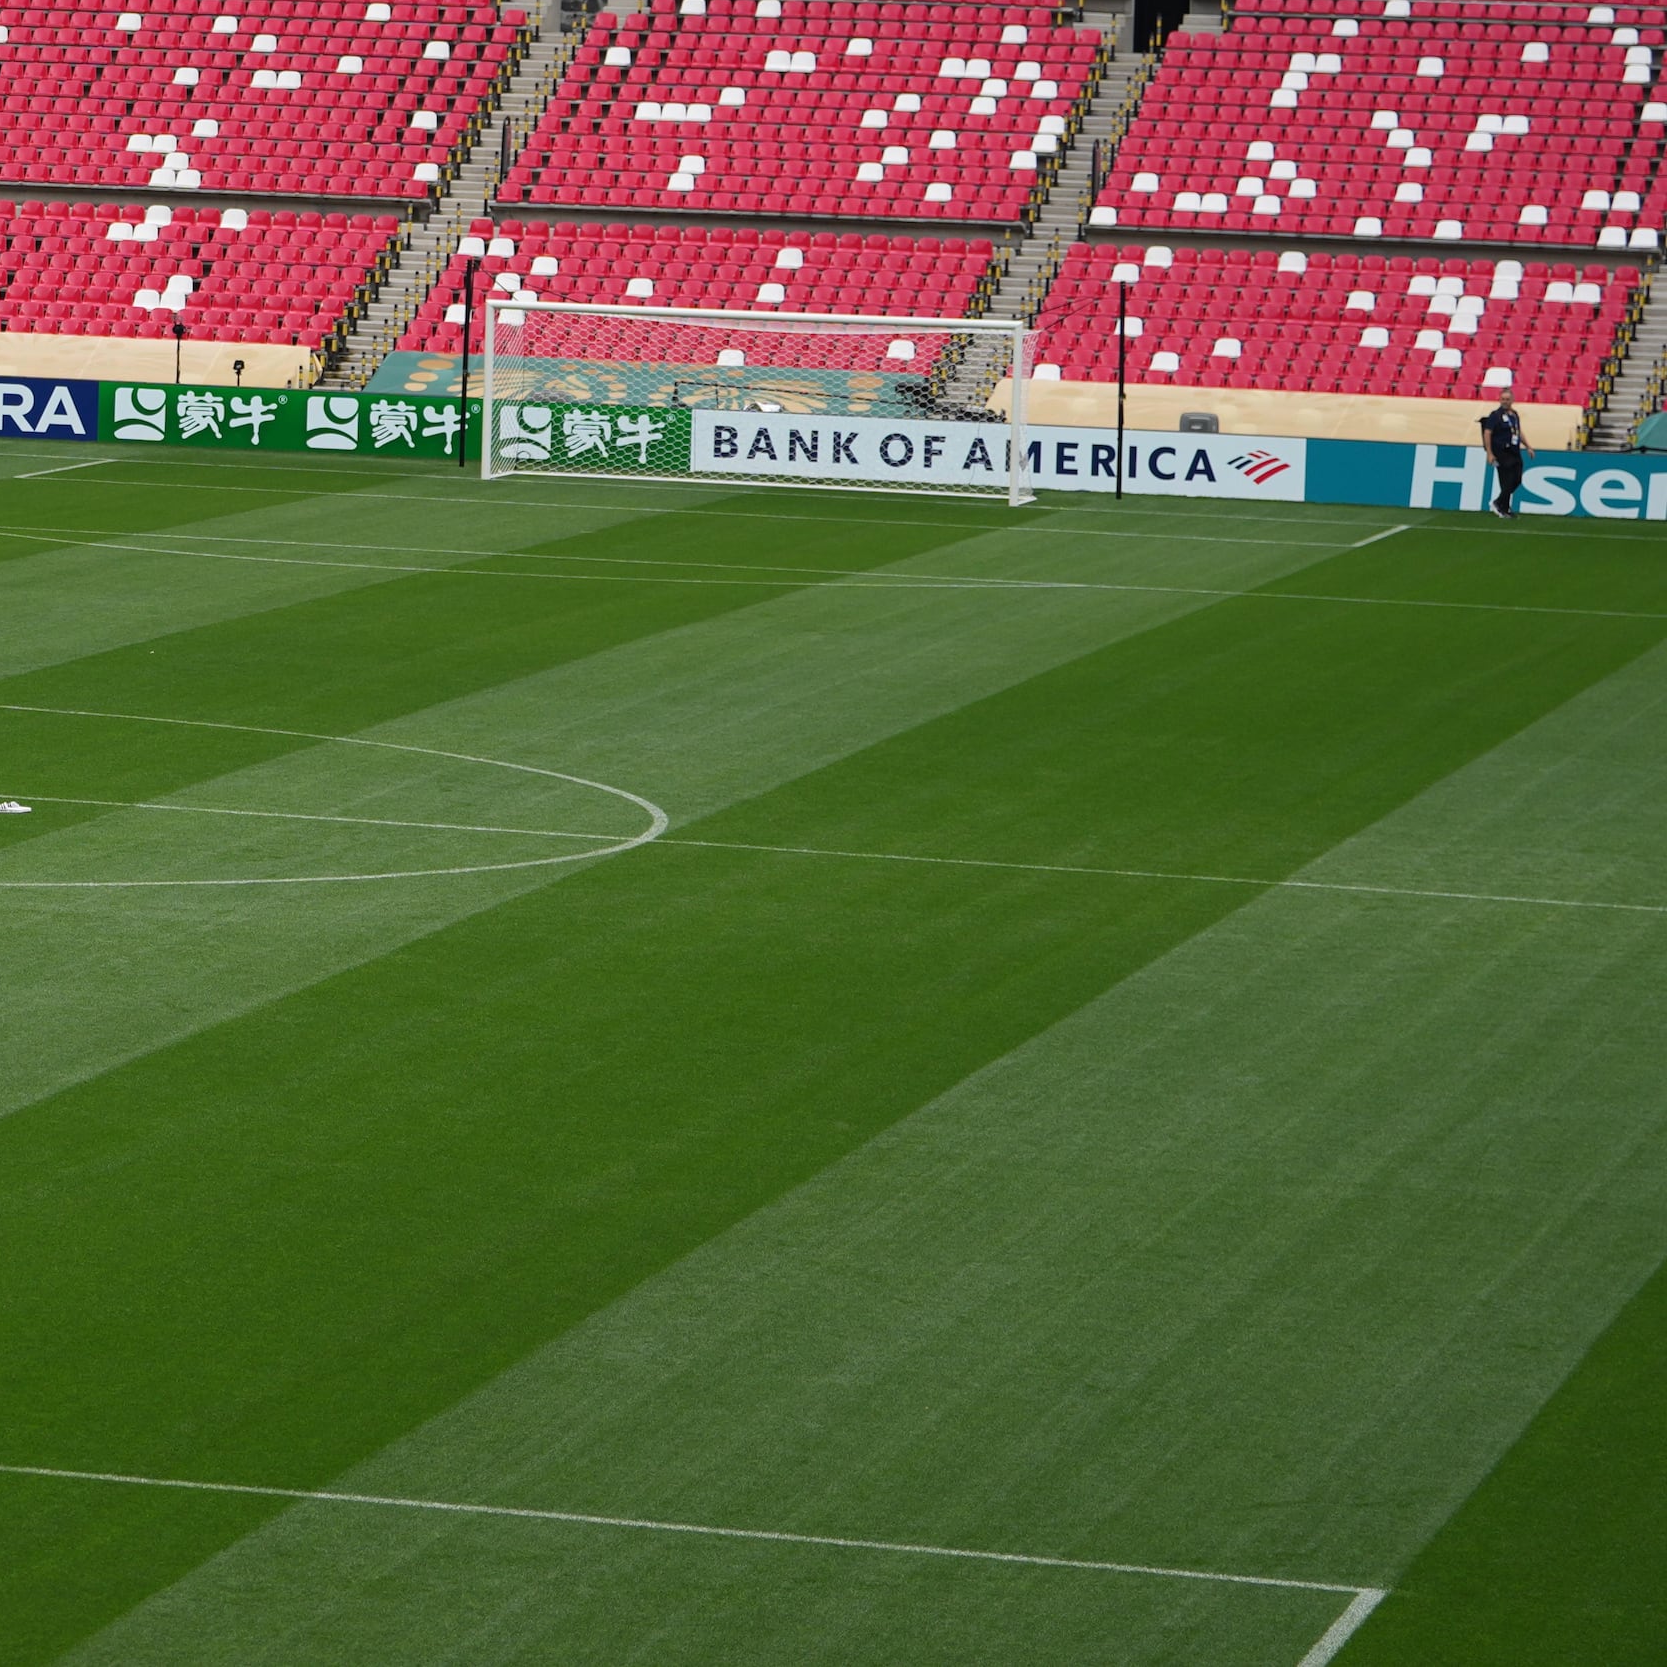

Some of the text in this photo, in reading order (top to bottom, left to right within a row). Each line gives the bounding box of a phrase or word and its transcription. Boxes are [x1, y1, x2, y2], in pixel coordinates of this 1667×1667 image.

[176, 390, 278, 446] 蒙牛
[368, 398, 471, 454] 蒙牛
[563, 409, 667, 464] 蒙牛
[712, 424, 1217, 483] BANK OF AMERICA
